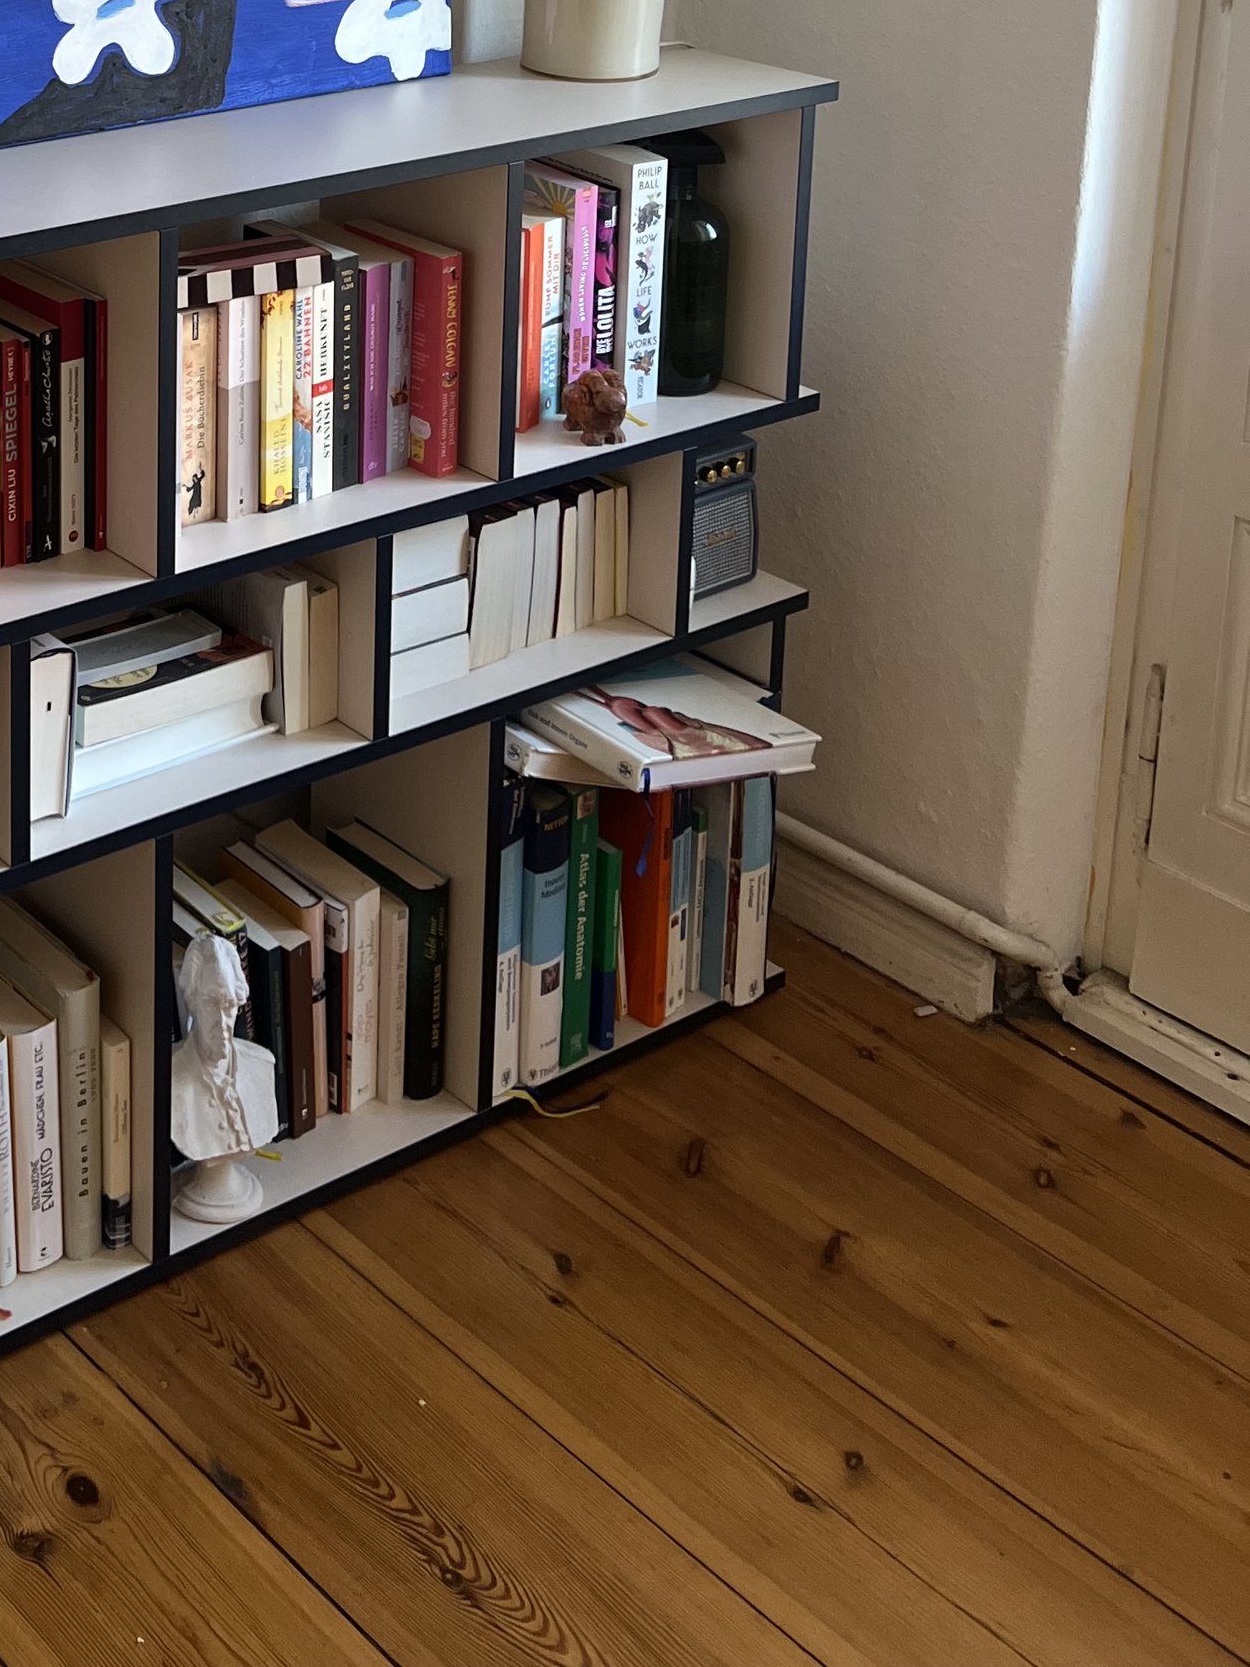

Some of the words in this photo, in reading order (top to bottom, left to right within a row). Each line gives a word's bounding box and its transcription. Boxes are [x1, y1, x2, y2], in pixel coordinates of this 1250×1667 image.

[637, 166, 662, 179] PHILIP
[639, 180, 659, 191] BALL
[636, 233, 658, 245] HOW
[546, 235, 554, 284] SOMMER
[579, 270, 587, 296] LIVING
[636, 286, 652, 297] LIFE
[295, 299, 303, 327] WAHL
[445, 284, 458, 319] JENNY
[596, 283, 616, 338] LOLITA
[303, 296, 312, 357] BAHNEN
[319, 307, 328, 377] HERKUNFT
[627, 337, 658, 349] WORKS
[295, 328, 303, 380] CAROLINE
[342, 303, 351, 410] QUALITYLAND
[445, 322, 458, 368] COLGAN
[304, 361, 312, 378] 22
[196, 365, 206, 429] Bücherdiebin
[4, 383, 18, 463] SPIEGEL
[184, 406, 193, 460] MARKUS
[197, 431, 206, 449] Die
[7, 468, 17, 487] LIU
[7, 490, 18, 522] CIXIN
[578, 853, 590, 888] Atlas
[578, 890, 590, 913] der
[238, 931, 248, 947] 17
[574, 916, 588, 982] Anatomie
[431, 963, 442, 1021] KERKELING
[430, 1022, 440, 1049] HAPE
[35, 1066, 44, 1090] FRAU
[75, 1051, 87, 1107] Berlin
[77, 1117, 87, 1135] in
[30, 1160, 40, 1212] BERNARDINE
[40, 1148, 55, 1212] EVARISTO
[77, 1144, 88, 1197] Bauen
